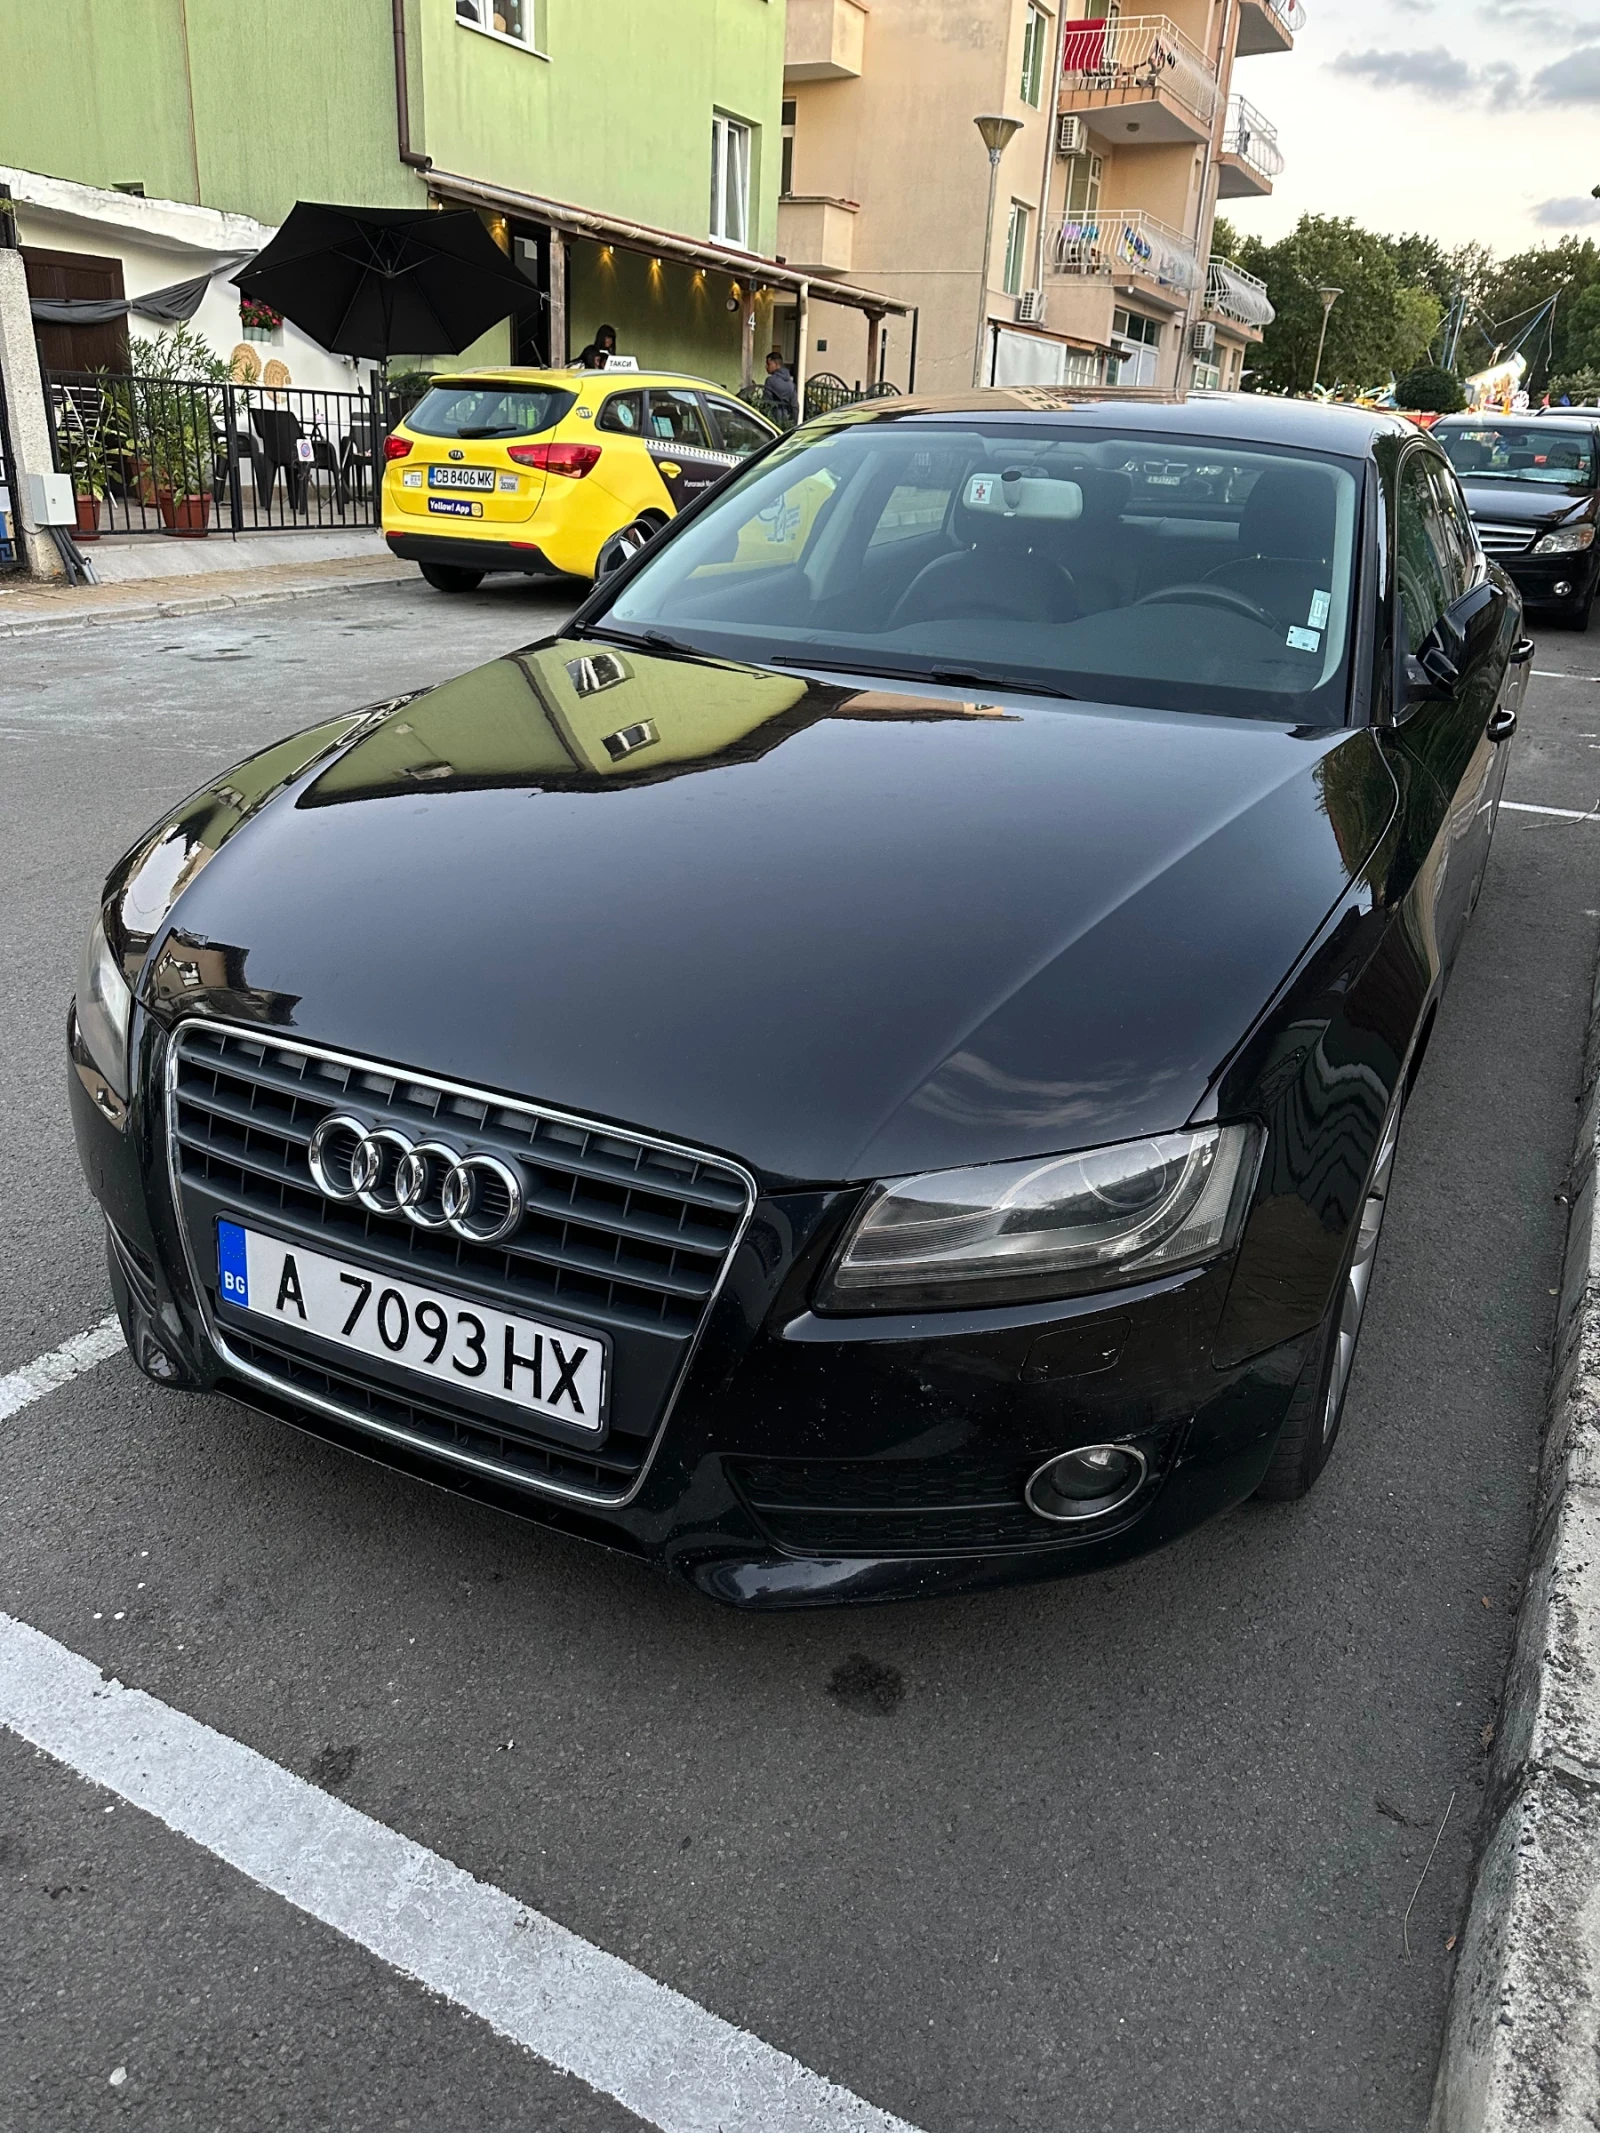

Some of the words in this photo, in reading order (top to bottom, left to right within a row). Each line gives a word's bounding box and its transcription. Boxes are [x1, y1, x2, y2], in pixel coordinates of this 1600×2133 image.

[748, 311, 756, 331] 4
[450, 450, 462, 458] KIA
[450, 470, 476, 485] 8406
[430, 500, 454, 512] Yellow!
[455, 503, 470, 514] App
[224, 1270, 246, 1295] BG
[275, 1252, 308, 1320] A
[339, 1272, 488, 1378] 7093
[503, 1324, 589, 1414] HX
